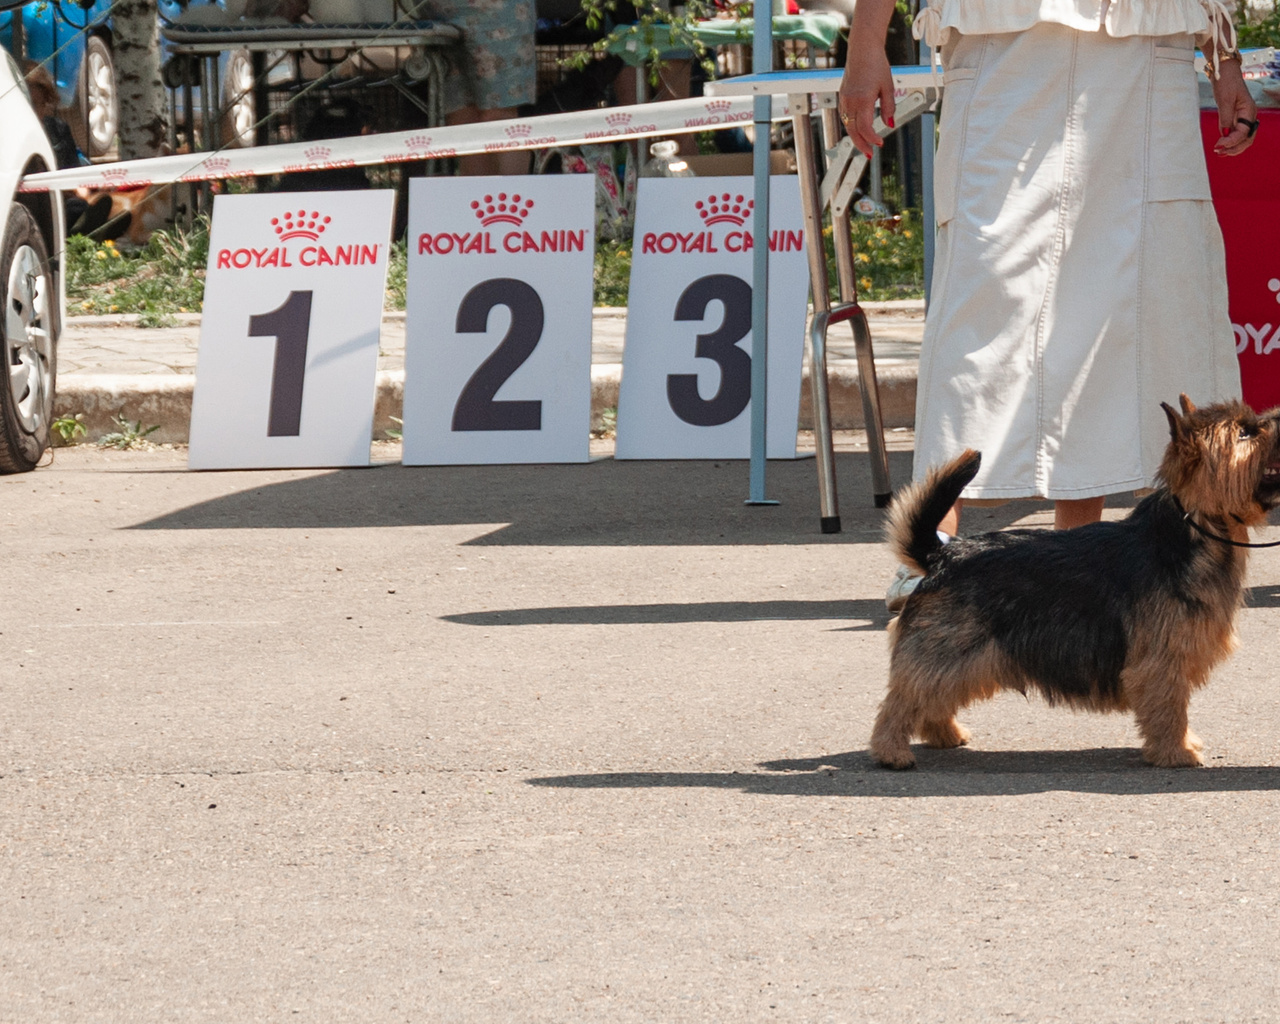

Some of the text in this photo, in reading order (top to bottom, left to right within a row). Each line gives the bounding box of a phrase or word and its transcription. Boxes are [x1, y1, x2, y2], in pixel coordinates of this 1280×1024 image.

[217, 244, 378, 269] ROYAL CANIN
[418, 229, 584, 255] ROYAL CANIN
[642, 231, 718, 254] ROYAL
[248, 290, 313, 437] 1
[451, 278, 545, 431] 2
[666, 274, 752, 426] 3
